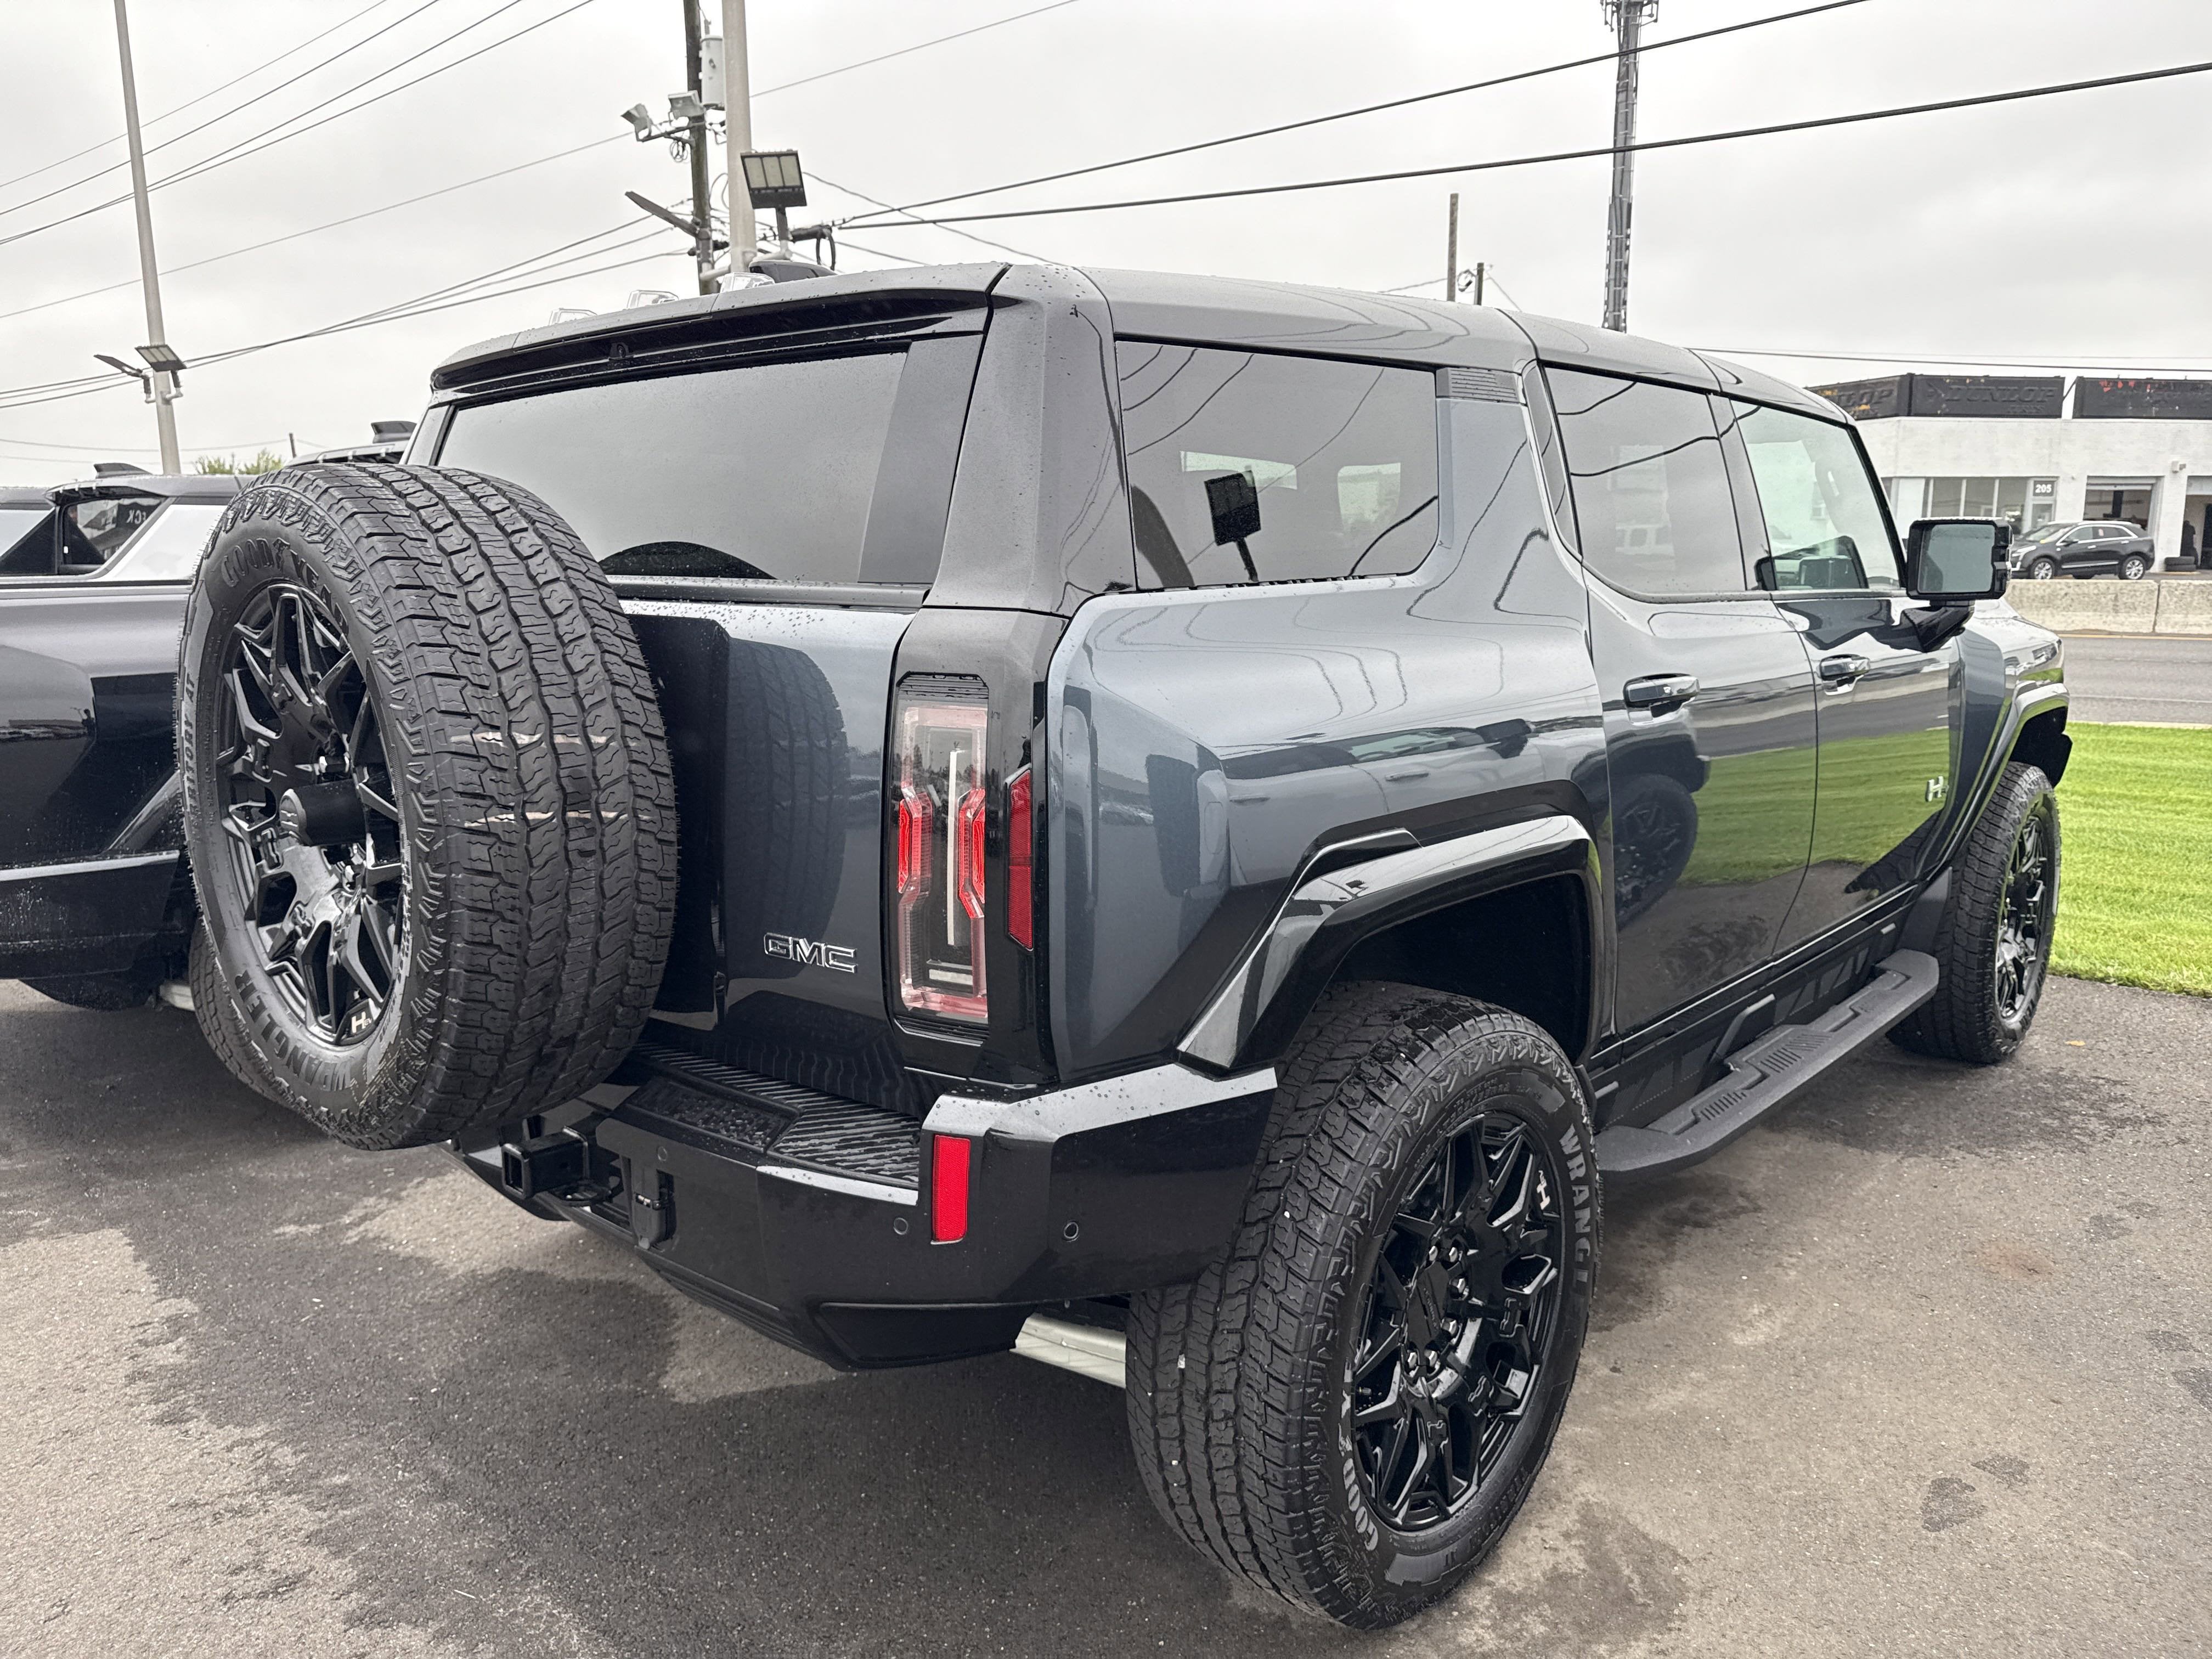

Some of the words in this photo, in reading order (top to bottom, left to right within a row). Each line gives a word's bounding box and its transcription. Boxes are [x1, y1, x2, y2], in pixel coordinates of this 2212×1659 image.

[1944, 386, 2057, 403] DUNLOP
[2035, 483, 2052, 493] 205
[221, 537, 349, 640] GOODYEAR
[185, 673, 194, 703] AT
[763, 932, 858, 974] GMC
[234, 969, 354, 1091] WRANGLER
[1559, 1123, 1590, 1317] WRANGL
[1338, 1328, 1379, 1551] GOODYE
